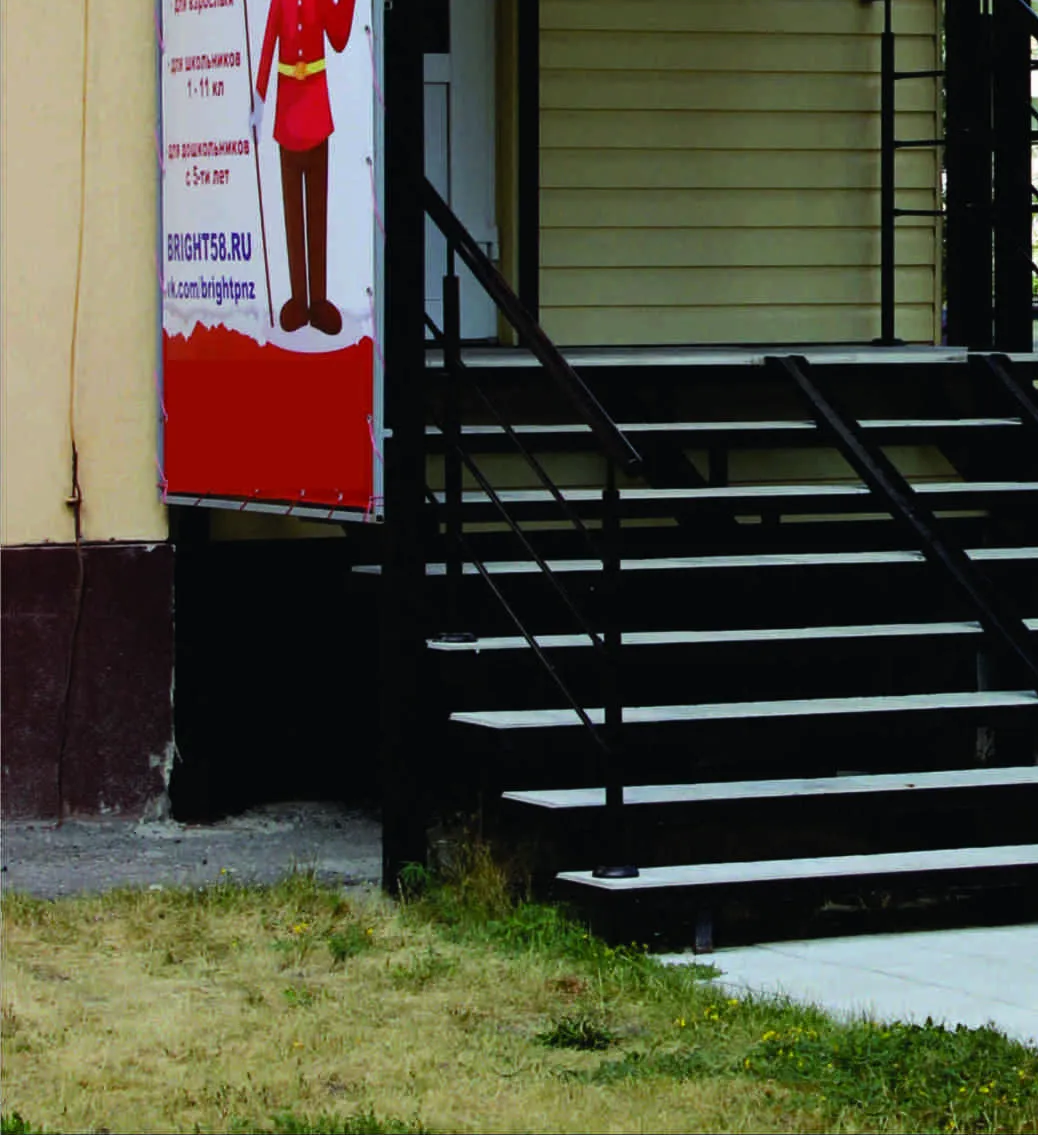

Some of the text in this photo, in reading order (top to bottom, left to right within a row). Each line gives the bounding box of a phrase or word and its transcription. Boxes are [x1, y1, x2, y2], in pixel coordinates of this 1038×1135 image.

[185, 51, 241, 72] школьников
[212, 80, 225, 97] кл
[181, 139, 250, 160] дошкольников
[213, 169, 230, 185] лет
[167, 231, 252, 262] BRIGHT58.RU
